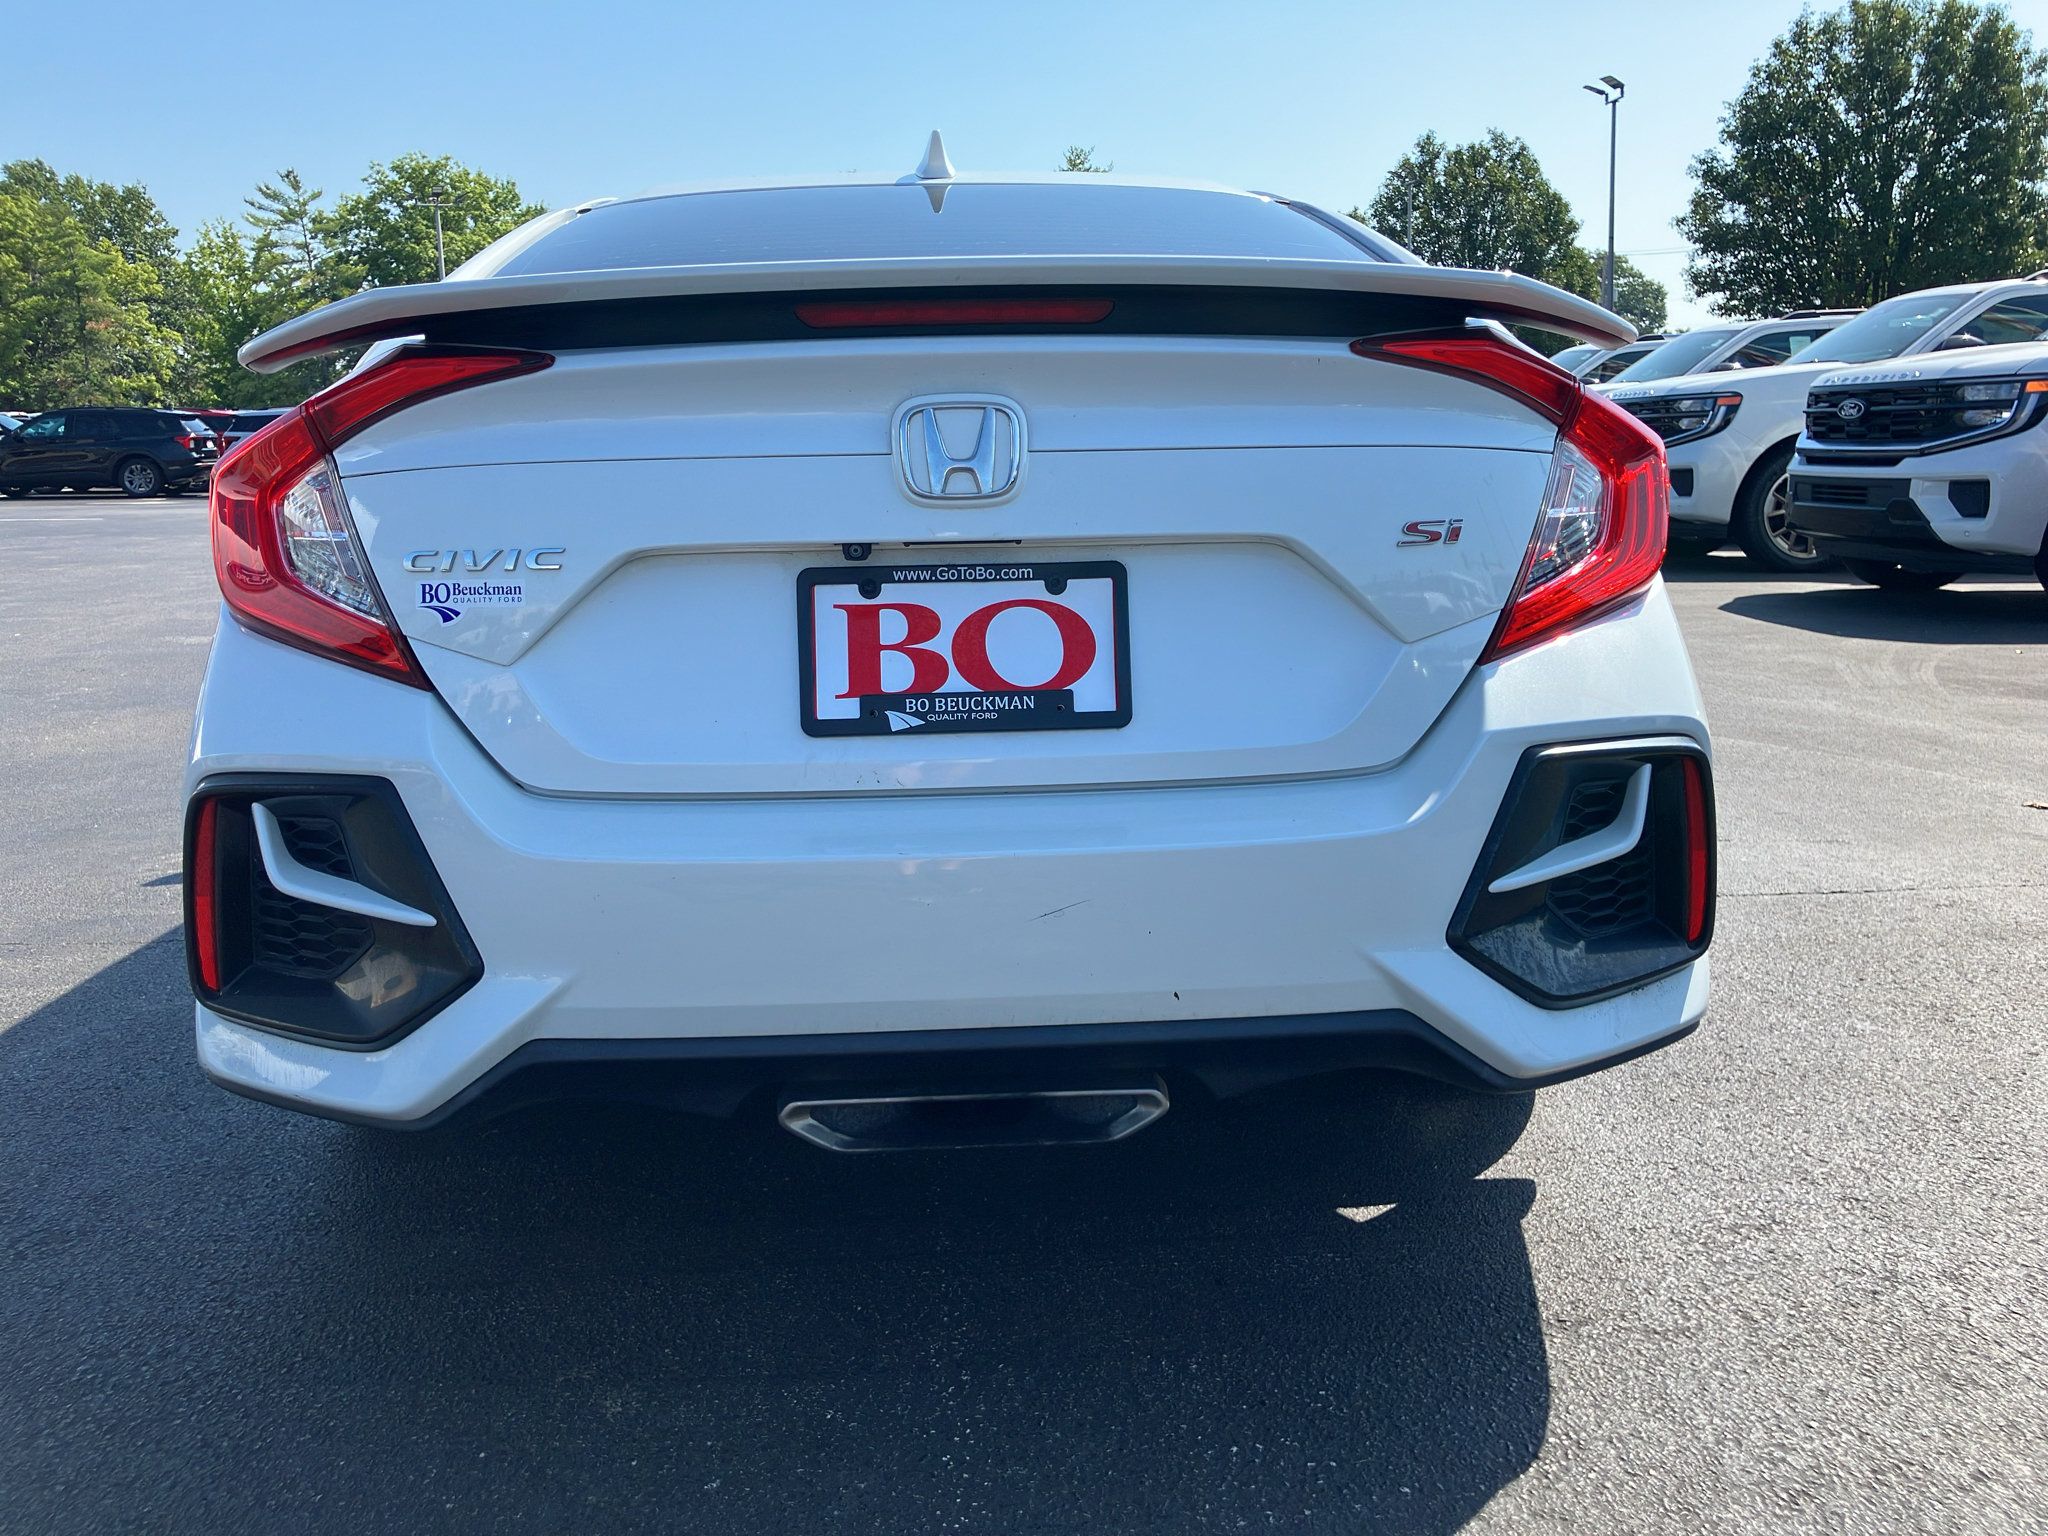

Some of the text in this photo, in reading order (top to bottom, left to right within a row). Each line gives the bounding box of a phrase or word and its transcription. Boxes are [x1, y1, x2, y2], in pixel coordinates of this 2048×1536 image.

[1397, 519, 1464, 547] Si
[402, 548, 566, 573] CIVIC
[893, 566, 1034, 581] www.GoToBo.com
[420, 581, 522, 604] BO Beuckman
[452, 596, 493, 604] QUALITY
[833, 598, 1097, 699] BO
[905, 695, 1035, 713] BO BEUCKMAN
[926, 712, 998, 722] QUALITY FORD
